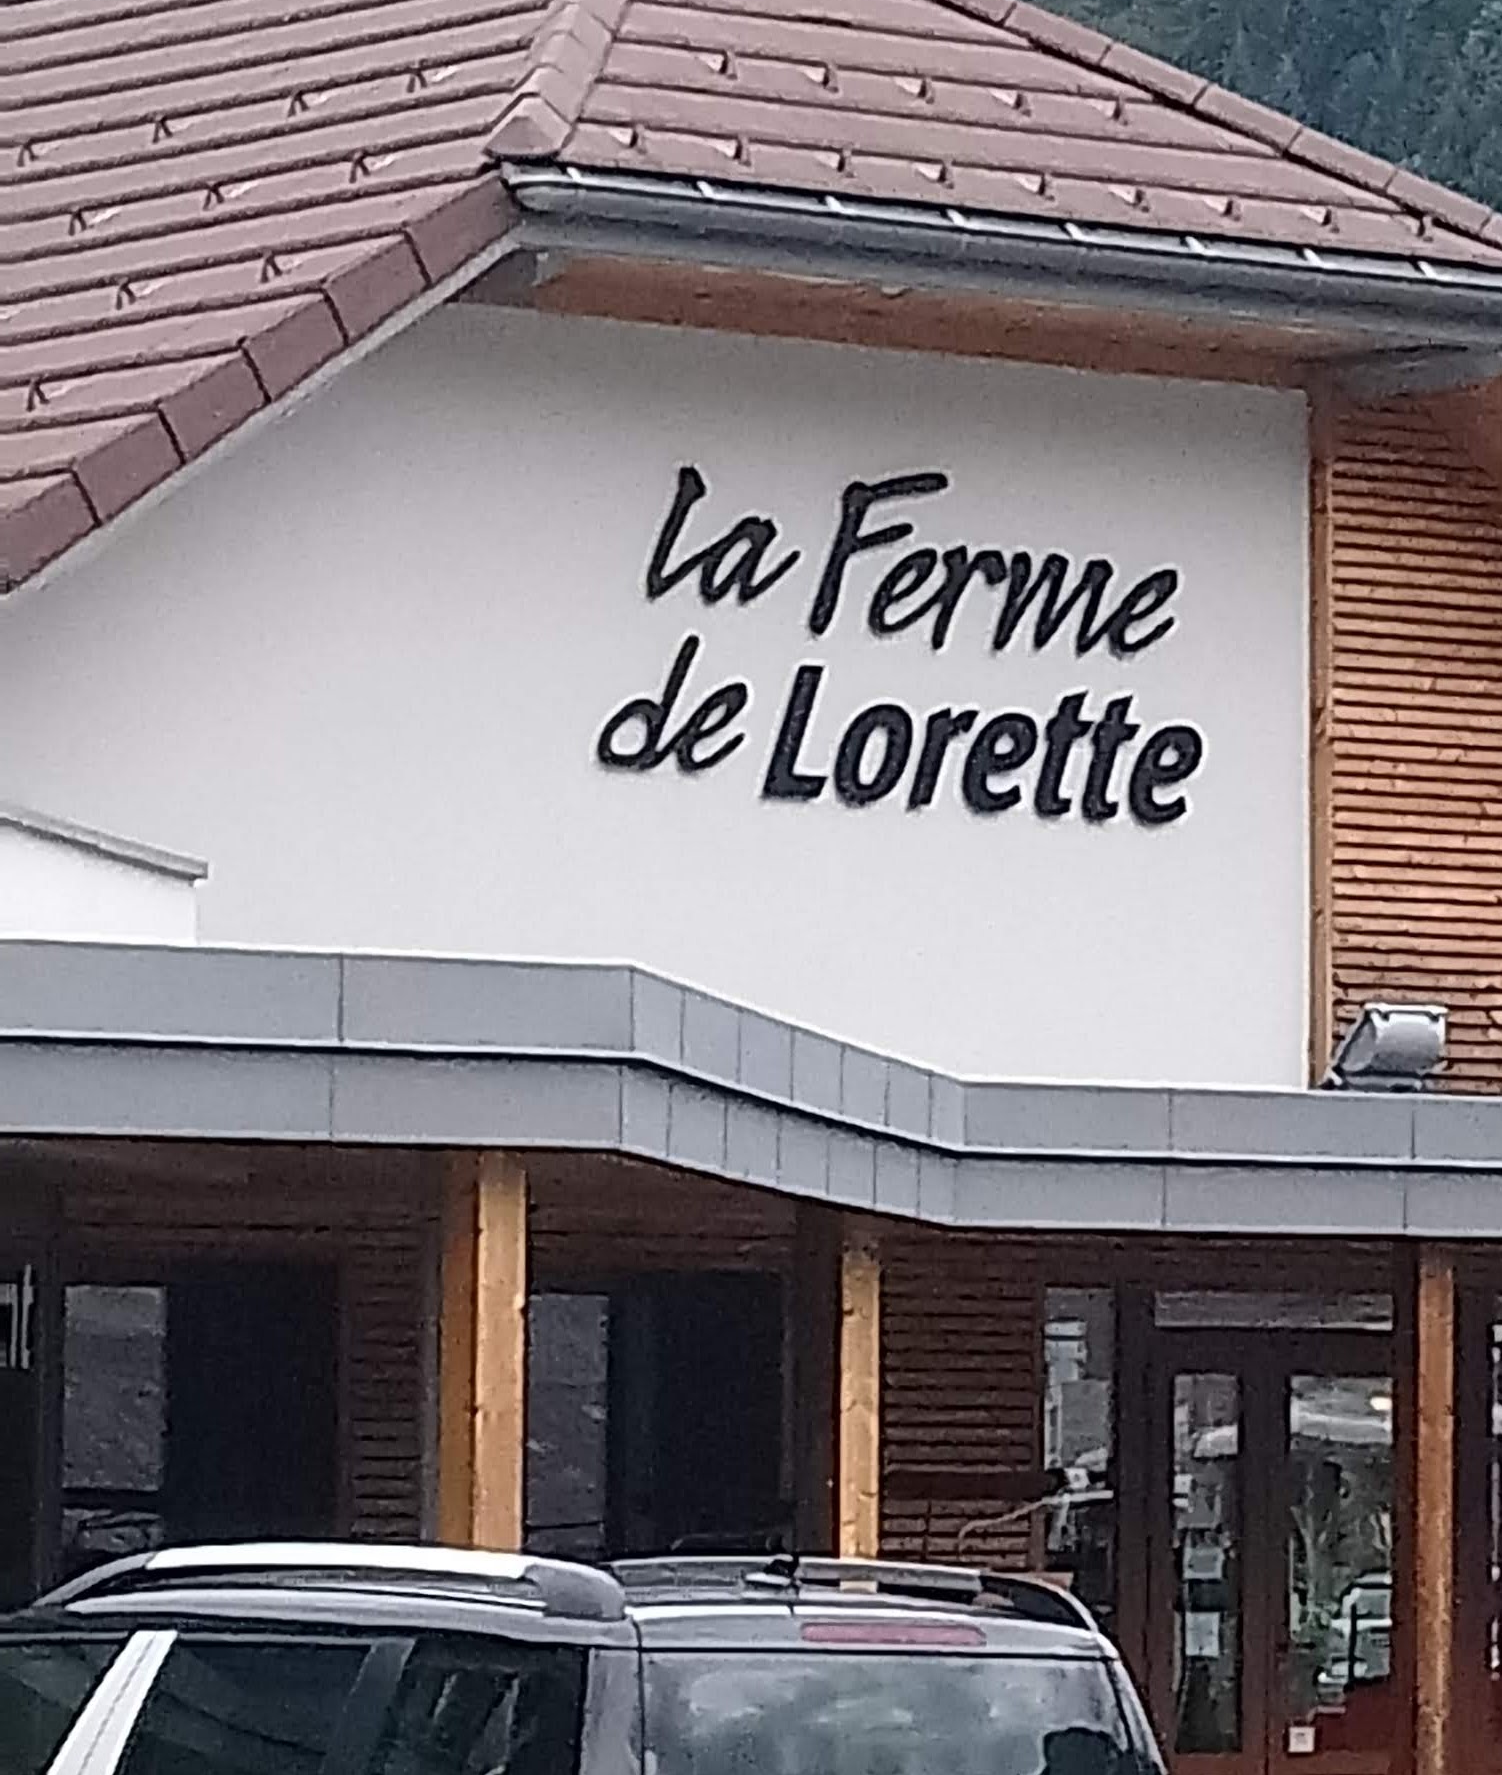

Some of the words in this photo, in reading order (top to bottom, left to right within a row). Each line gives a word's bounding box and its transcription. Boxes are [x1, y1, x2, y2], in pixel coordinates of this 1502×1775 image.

[808, 471, 1178, 659] Ferme
[597, 634, 748, 774] de
[761, 665, 1203, 827] Lorette
